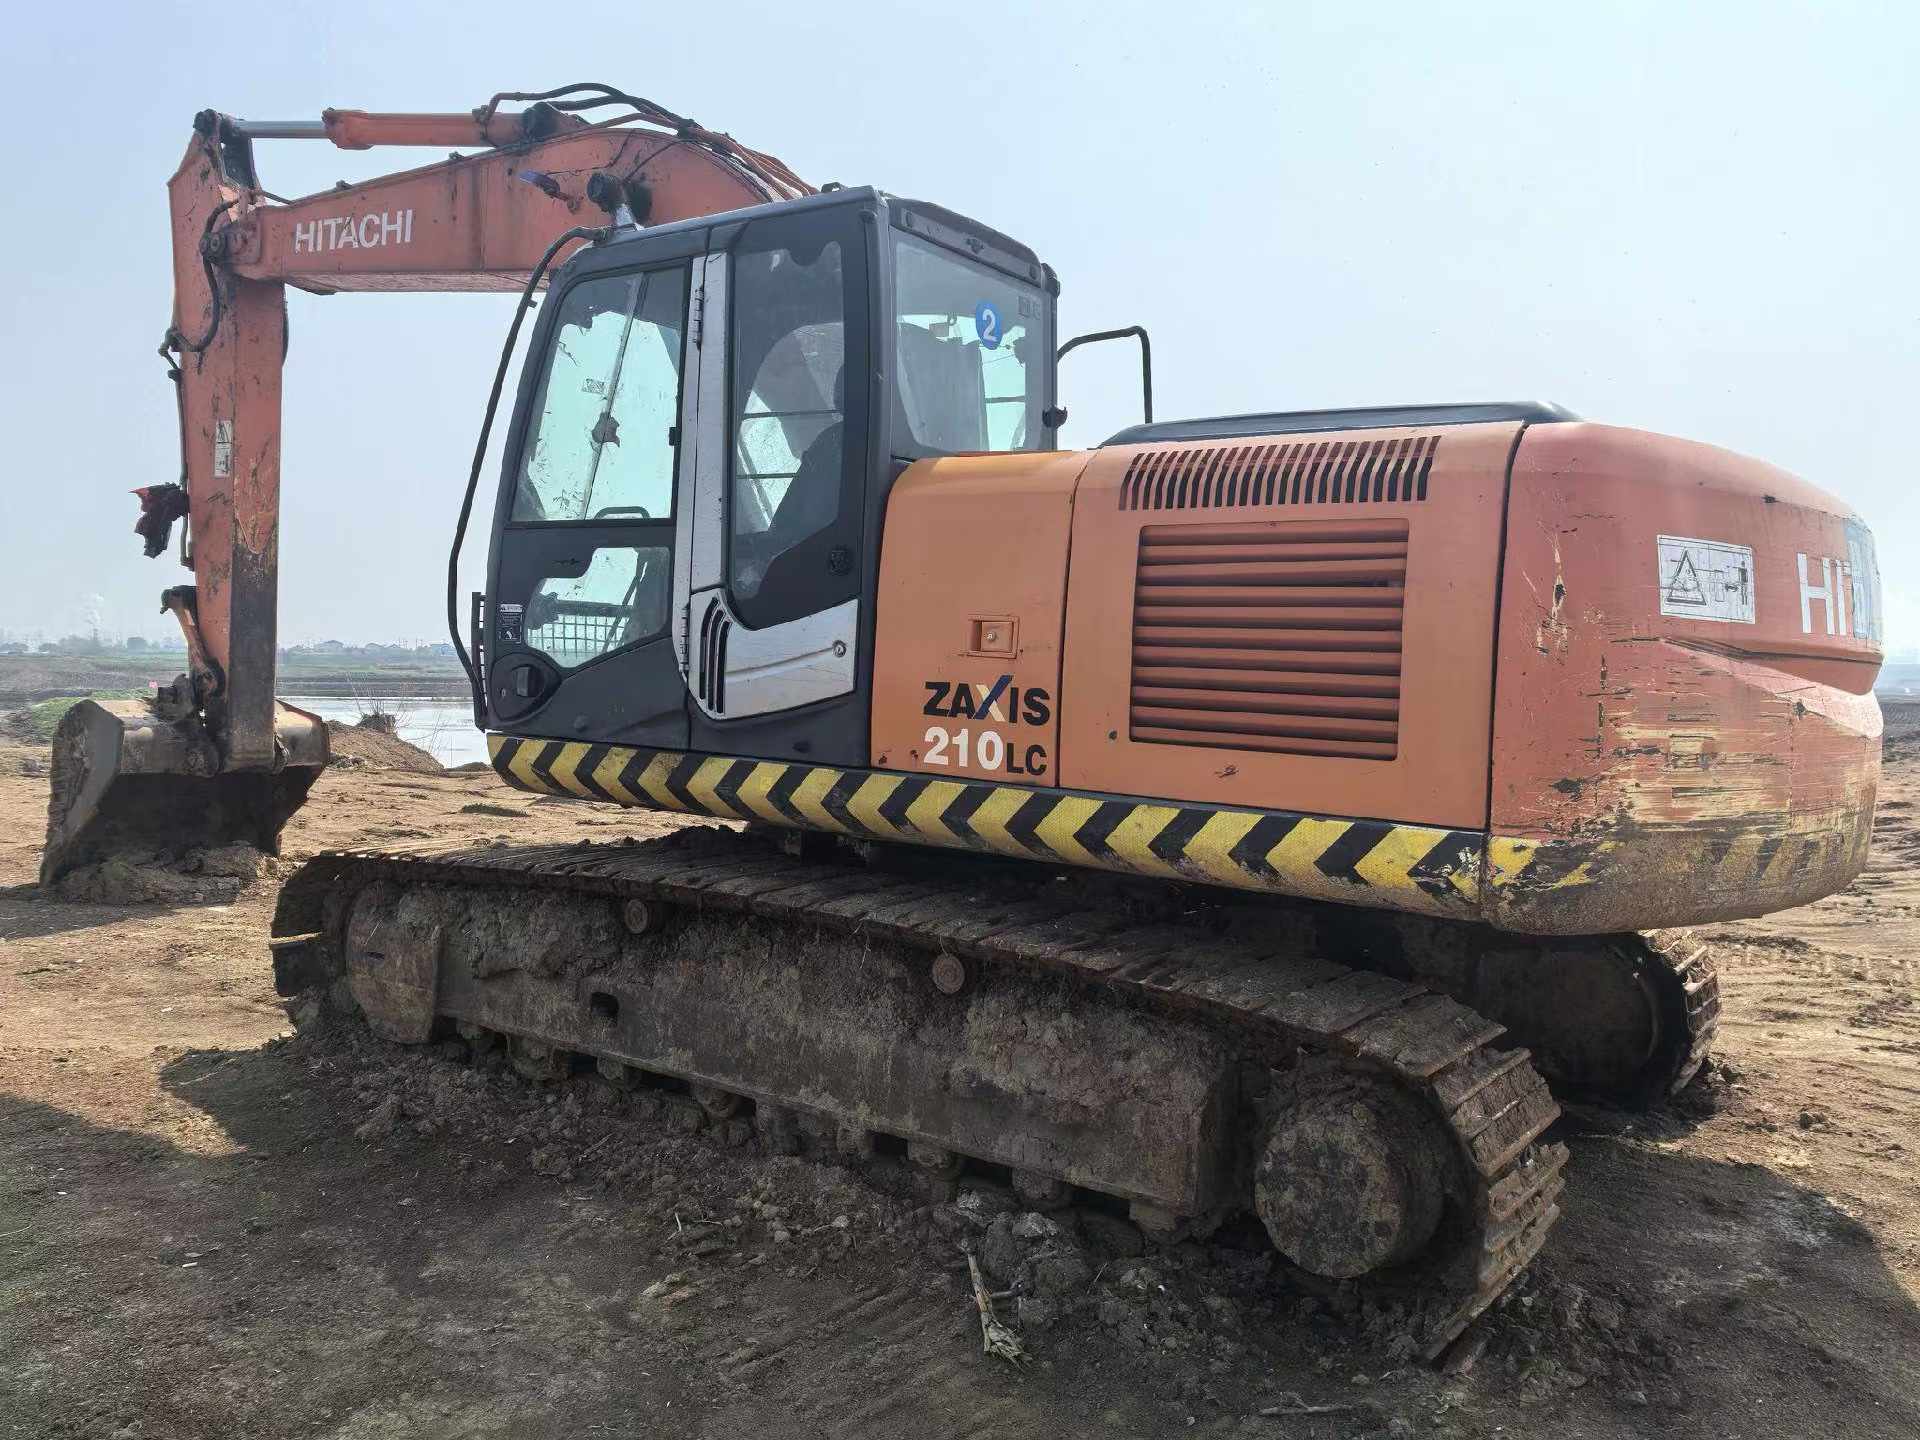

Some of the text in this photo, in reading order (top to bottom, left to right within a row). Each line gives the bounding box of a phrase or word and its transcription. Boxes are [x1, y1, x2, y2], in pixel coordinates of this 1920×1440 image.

[294, 209, 413, 253] HITACHI
[982, 309, 997, 342] 2
[1797, 552, 1852, 636] HI
[923, 674, 1051, 726] ZAXIS
